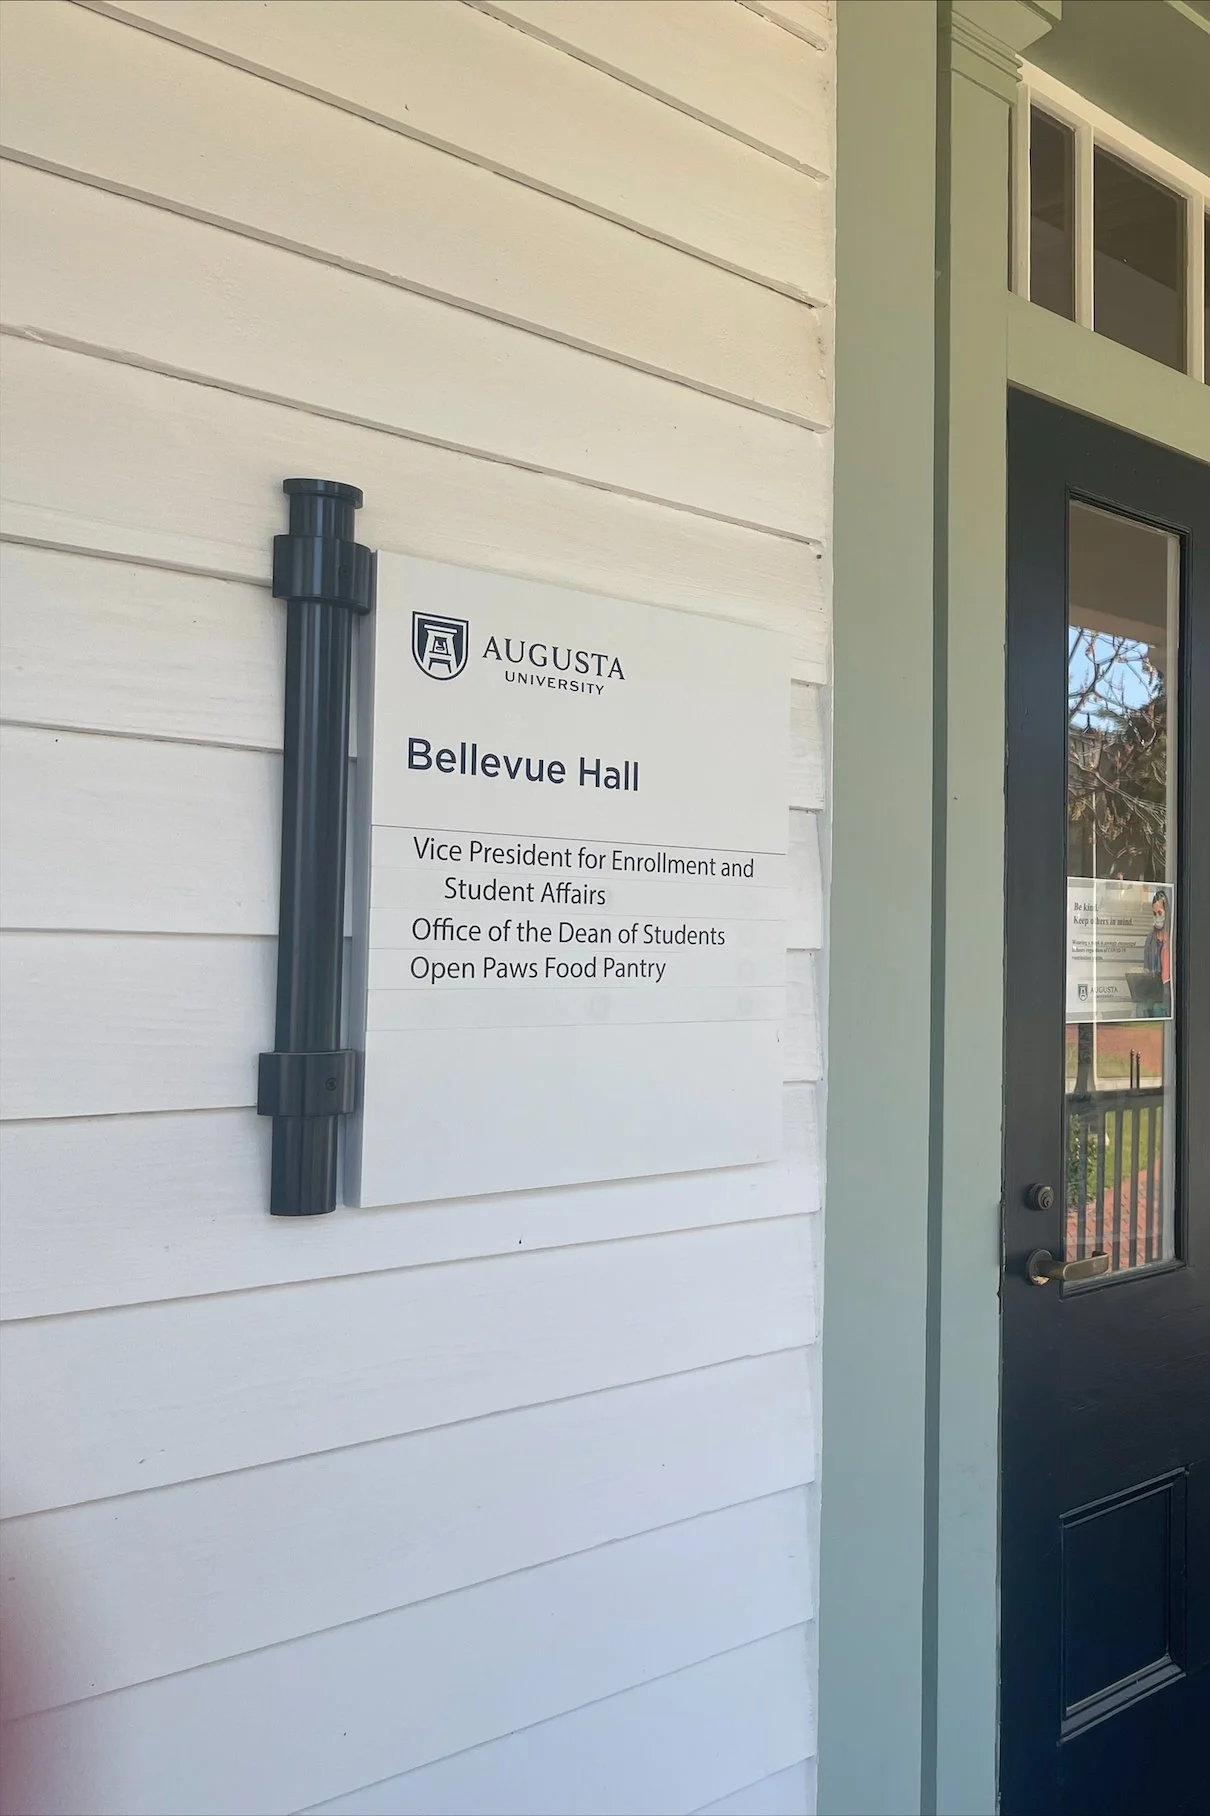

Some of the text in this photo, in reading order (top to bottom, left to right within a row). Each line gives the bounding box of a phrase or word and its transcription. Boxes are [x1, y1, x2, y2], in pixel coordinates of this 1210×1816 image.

[481, 635, 626, 681] AUGUSTA
[504, 670, 605, 696] UNIVERSITY
[407, 736, 639, 792] Bellevue Hall
[412, 836, 754, 878] Vice President for Enrollment and
[444, 876, 606, 906] Student Affairs
[1073, 915, 1089, 927] Keep
[1090, 916, 1109, 925] ohers
[1074, 902, 1082, 911] Be
[411, 917, 726, 946] Office of the Dean of Students
[410, 955, 667, 985] Open Paws Food Pantry
